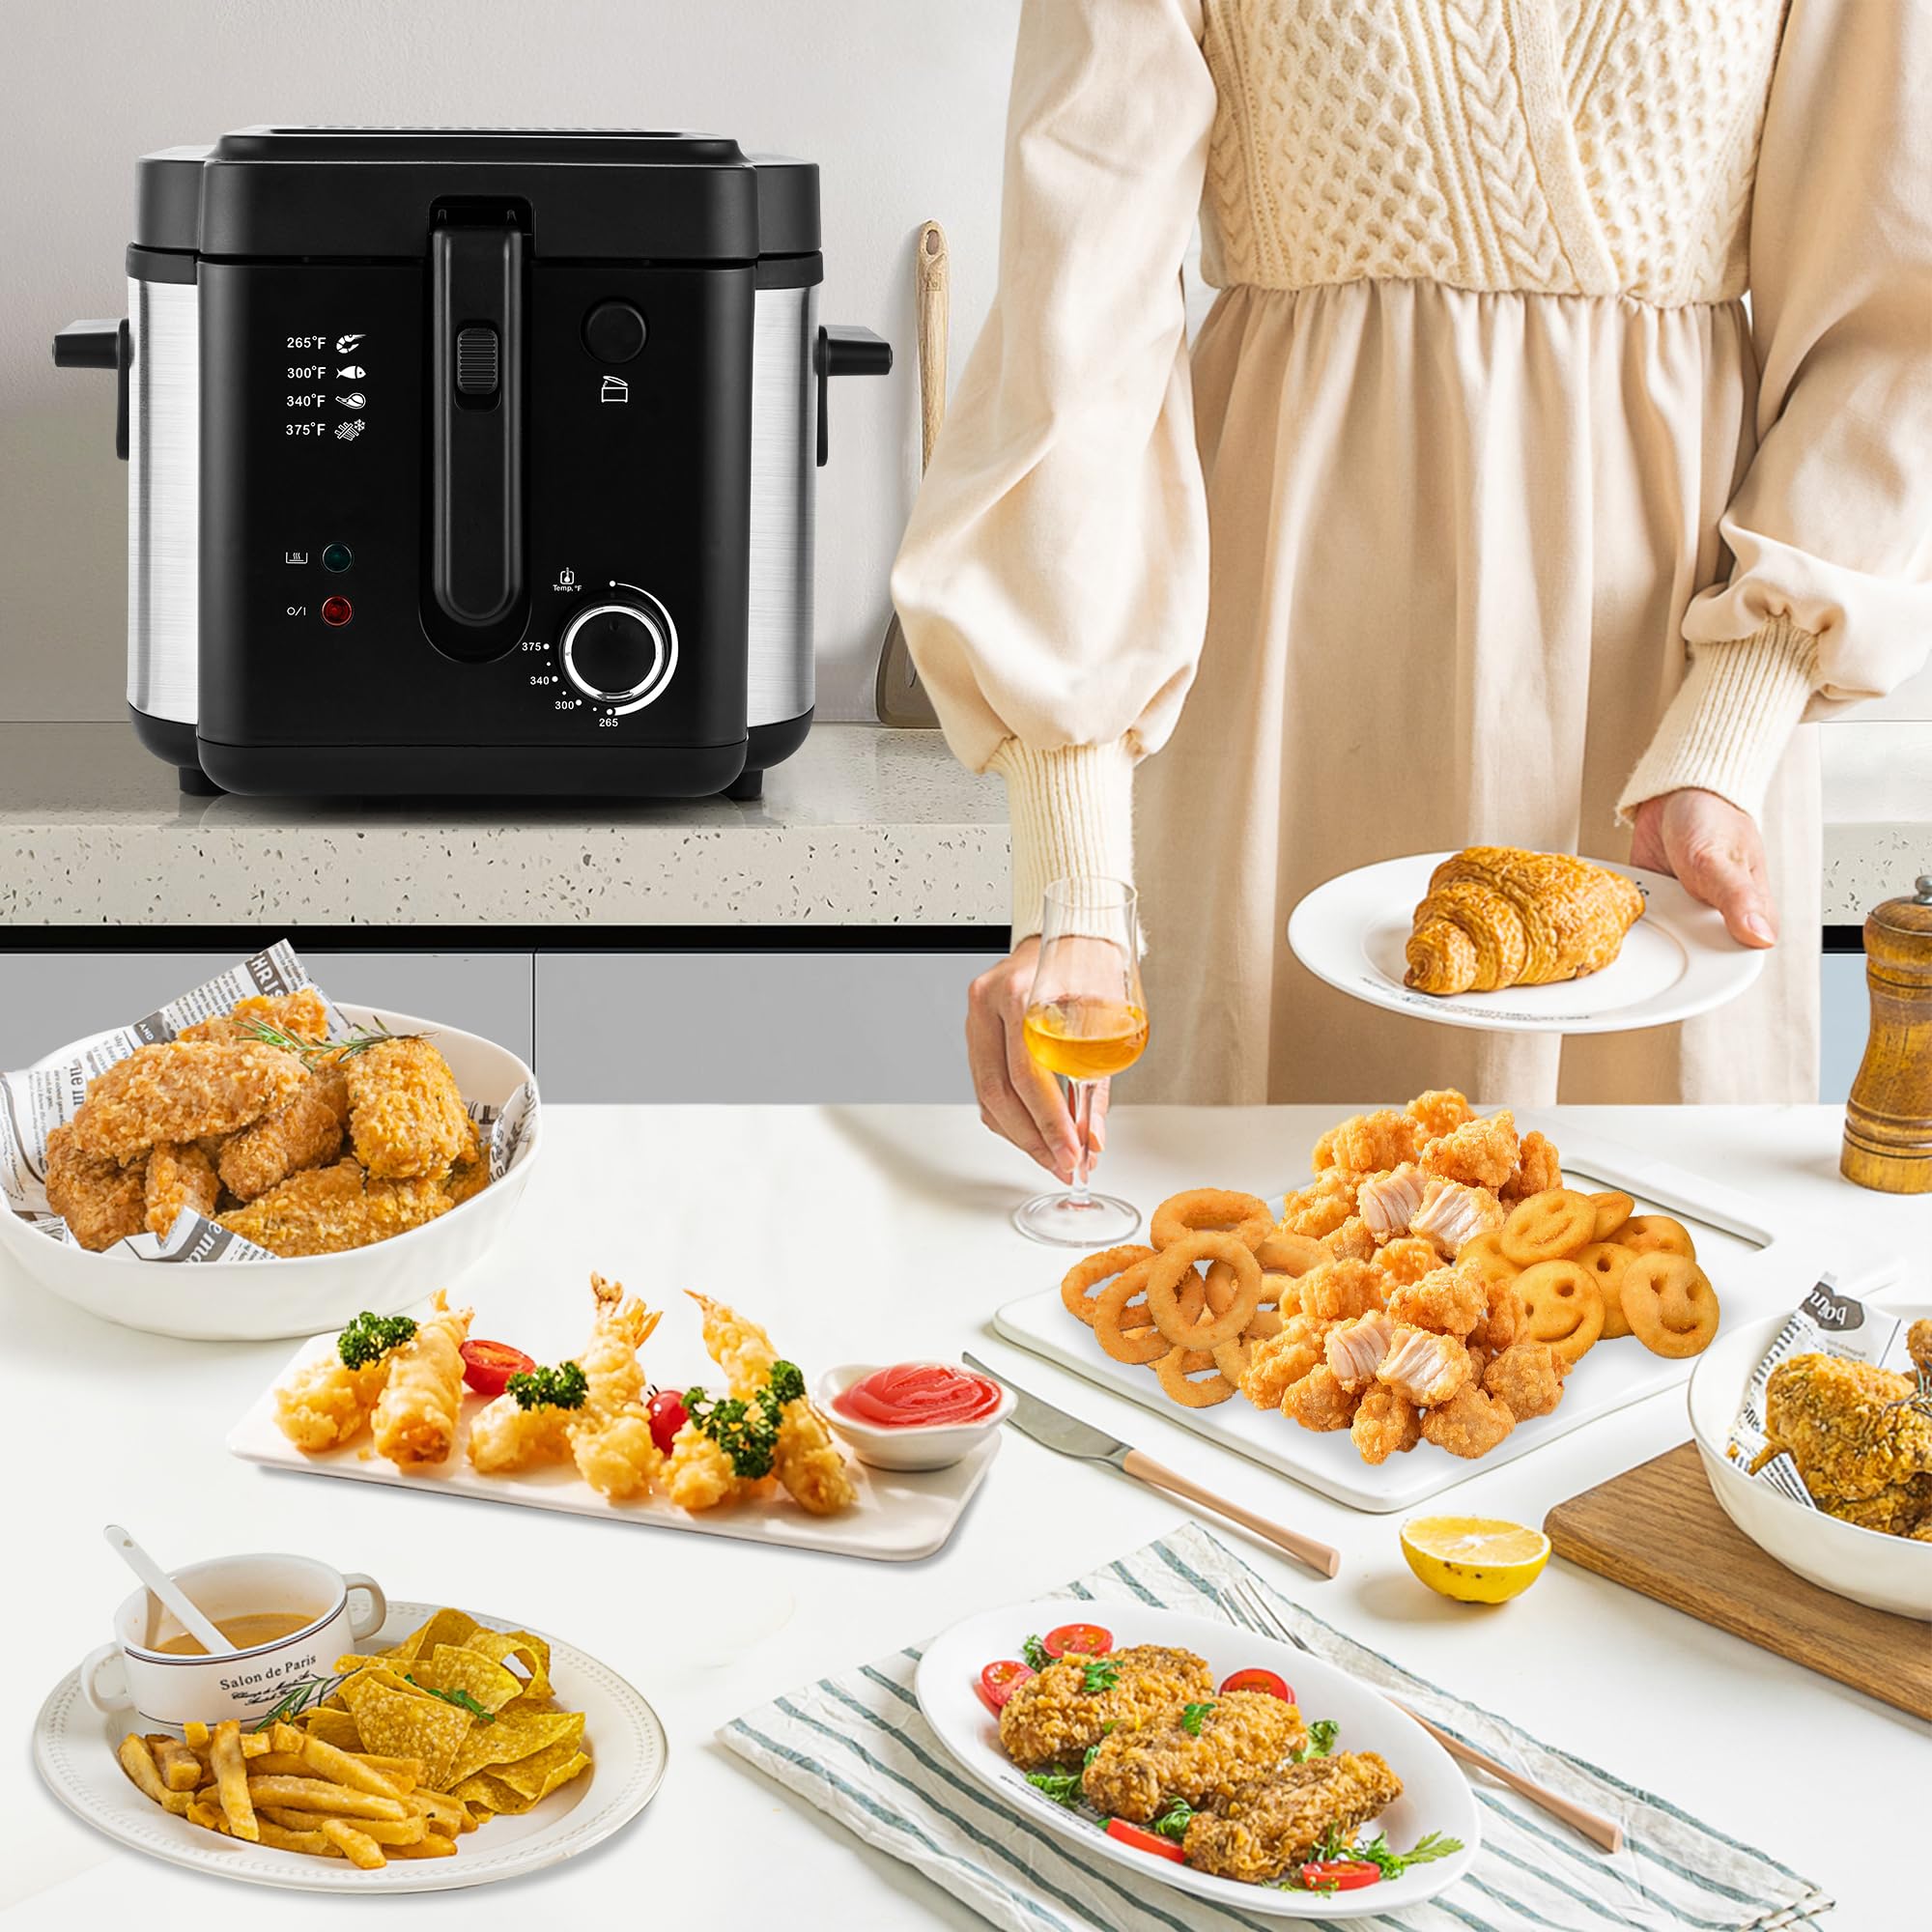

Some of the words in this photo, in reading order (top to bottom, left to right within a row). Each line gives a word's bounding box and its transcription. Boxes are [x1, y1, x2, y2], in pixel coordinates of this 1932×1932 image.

[287, 335, 327, 350] 265°F
[287, 364, 327, 380] 300°F
[286, 392, 327, 408] 340°F
[286, 421, 327, 436] 375°F
[522, 641, 542, 651] 375
[529, 675, 550, 686] 340
[554, 700, 575, 710] 300
[598, 718, 619, 727] 265
[219, 1674, 263, 1690] Salon
[265, 1667, 281, 1679] de
[285, 1654, 317, 1673] Paris
